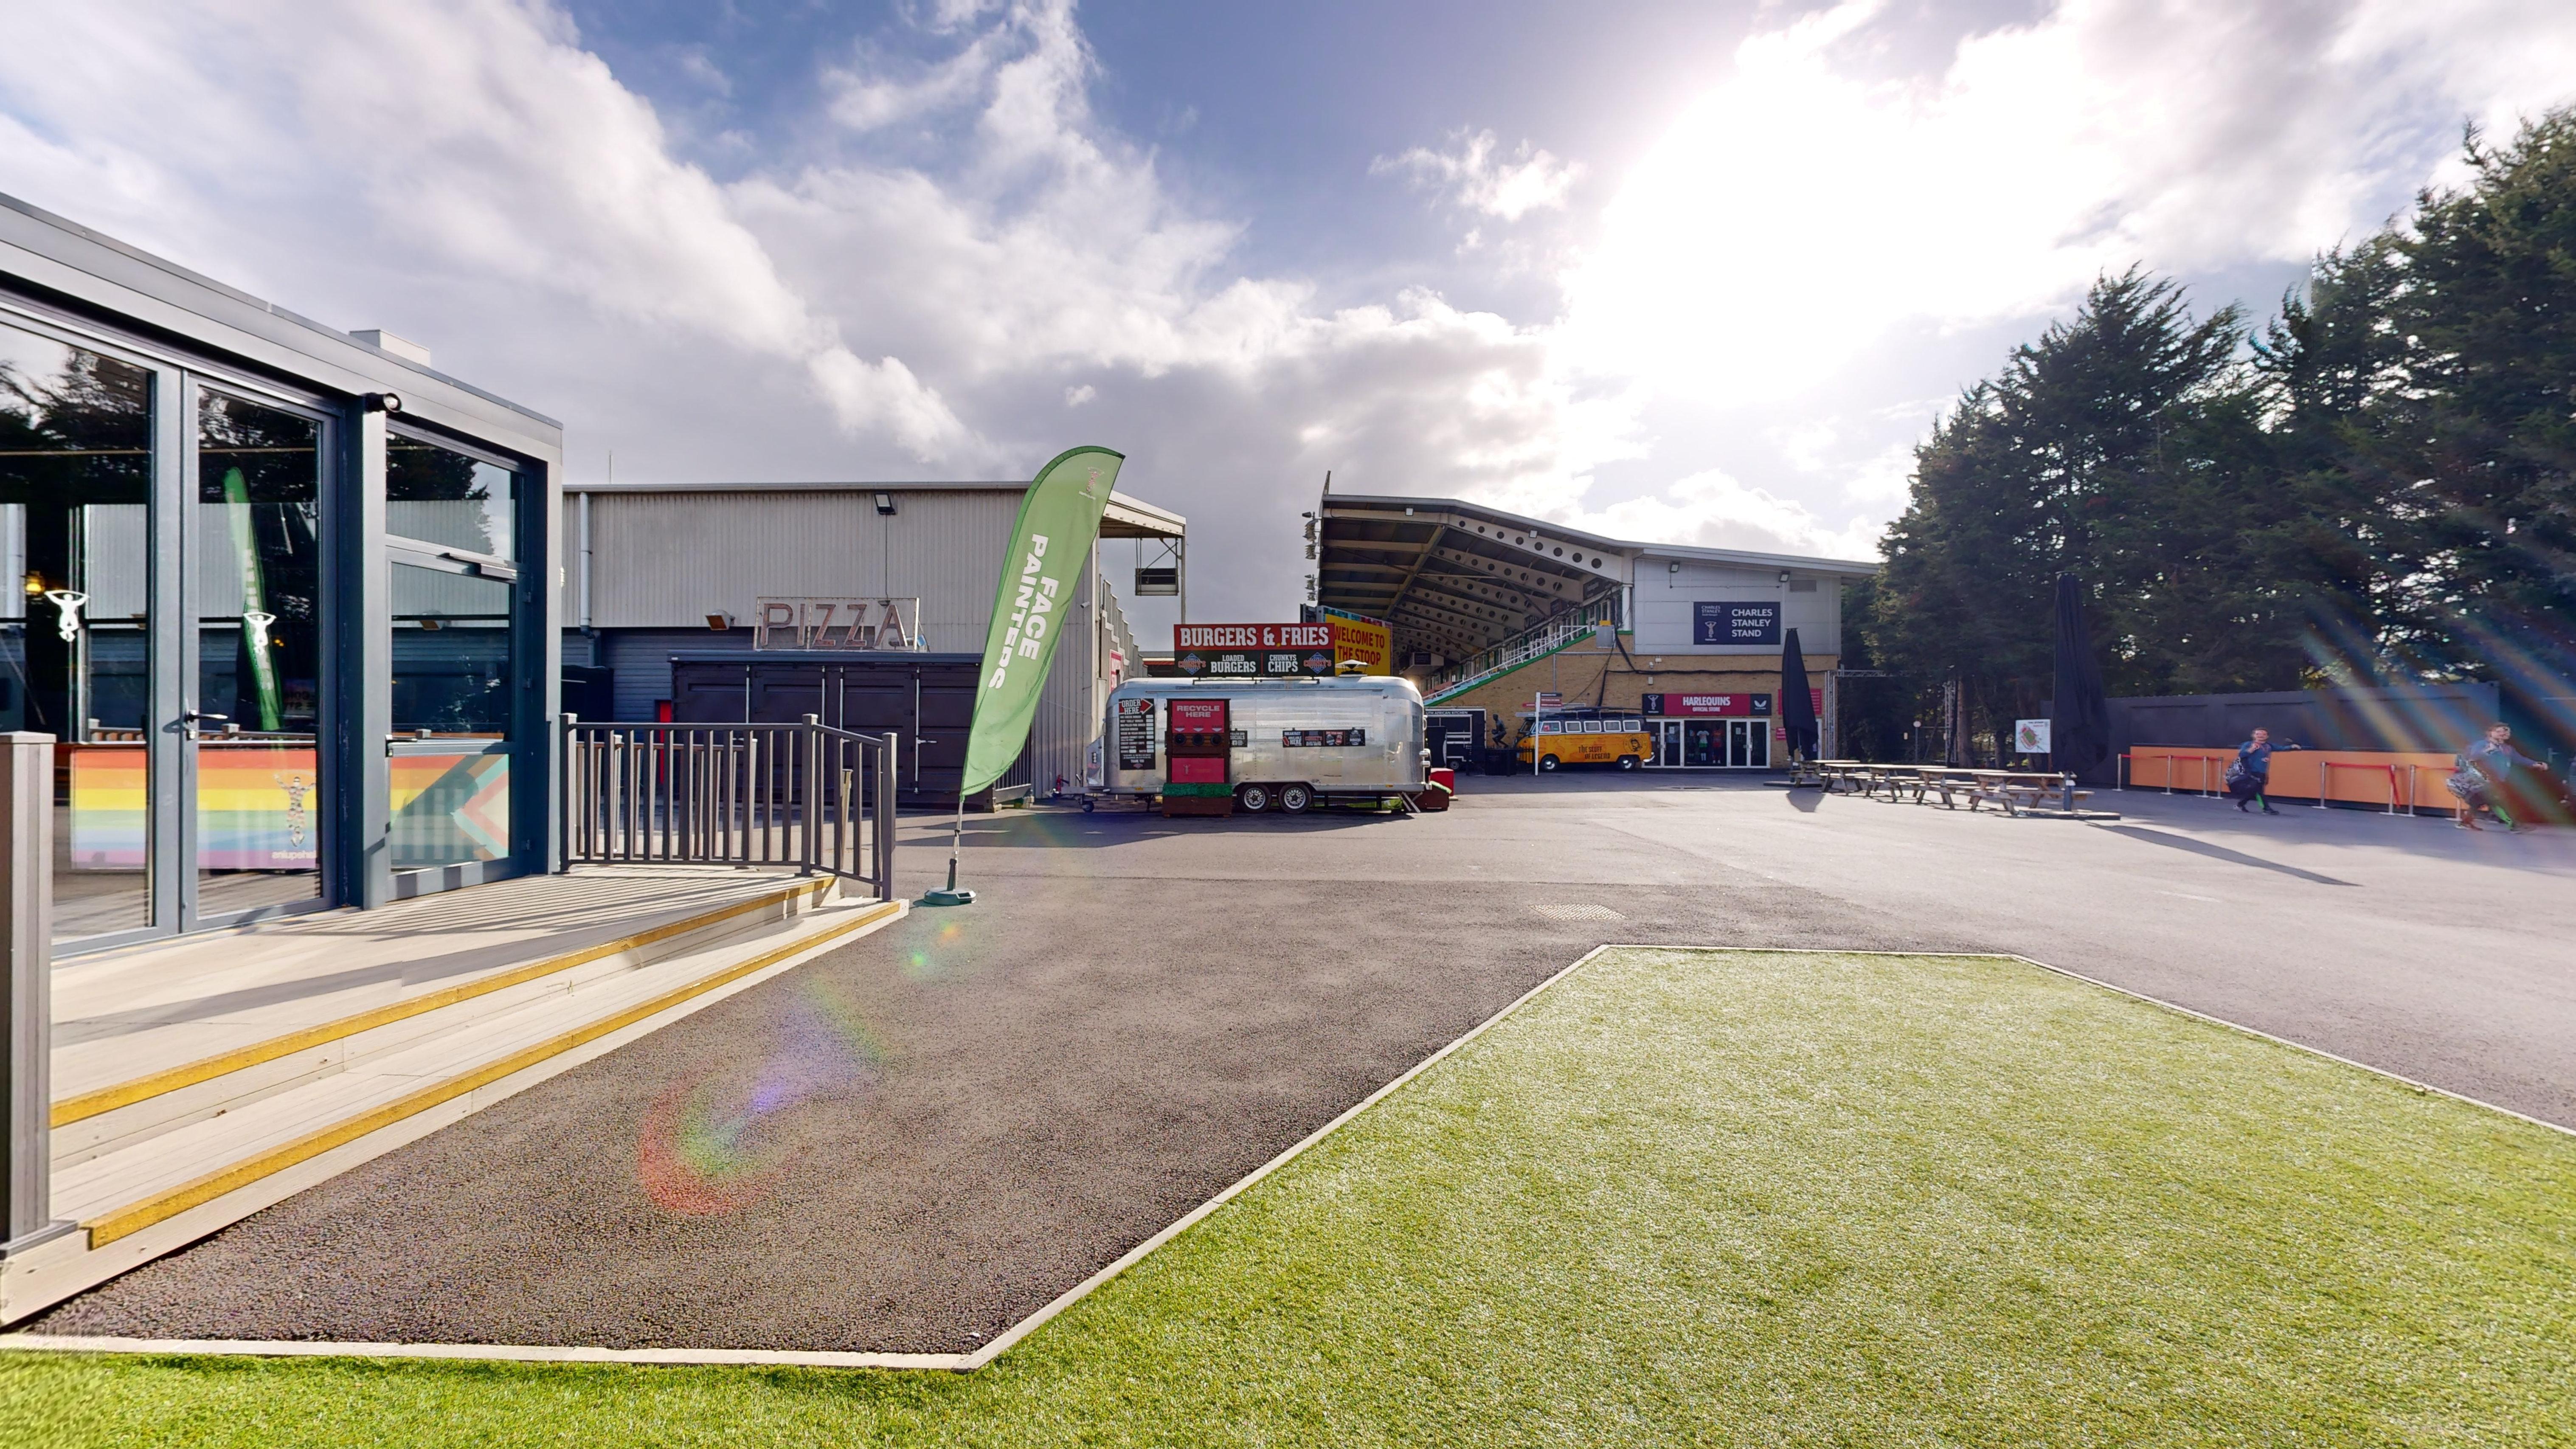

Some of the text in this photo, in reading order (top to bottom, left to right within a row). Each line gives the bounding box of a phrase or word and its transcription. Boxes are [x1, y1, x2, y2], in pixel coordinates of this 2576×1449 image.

[988, 534, 1049, 689] PAINTERS
[1018, 576, 1059, 660] FACE
[760, 603, 908, 648] PIZZA
[1180, 627, 1329, 646] BURGERS & FRIES
[1335, 626, 1385, 649] WELCOME TO
[1338, 646, 1381, 666] THE STOOP
[1211, 661, 1256, 672] BURGERS
[1268, 661, 1298, 672] CHIPS
[1122, 699, 1141, 707] ORDER
[1125, 706, 1140, 715] HERE
[1683, 697, 1731, 706] HARLEQUINS
